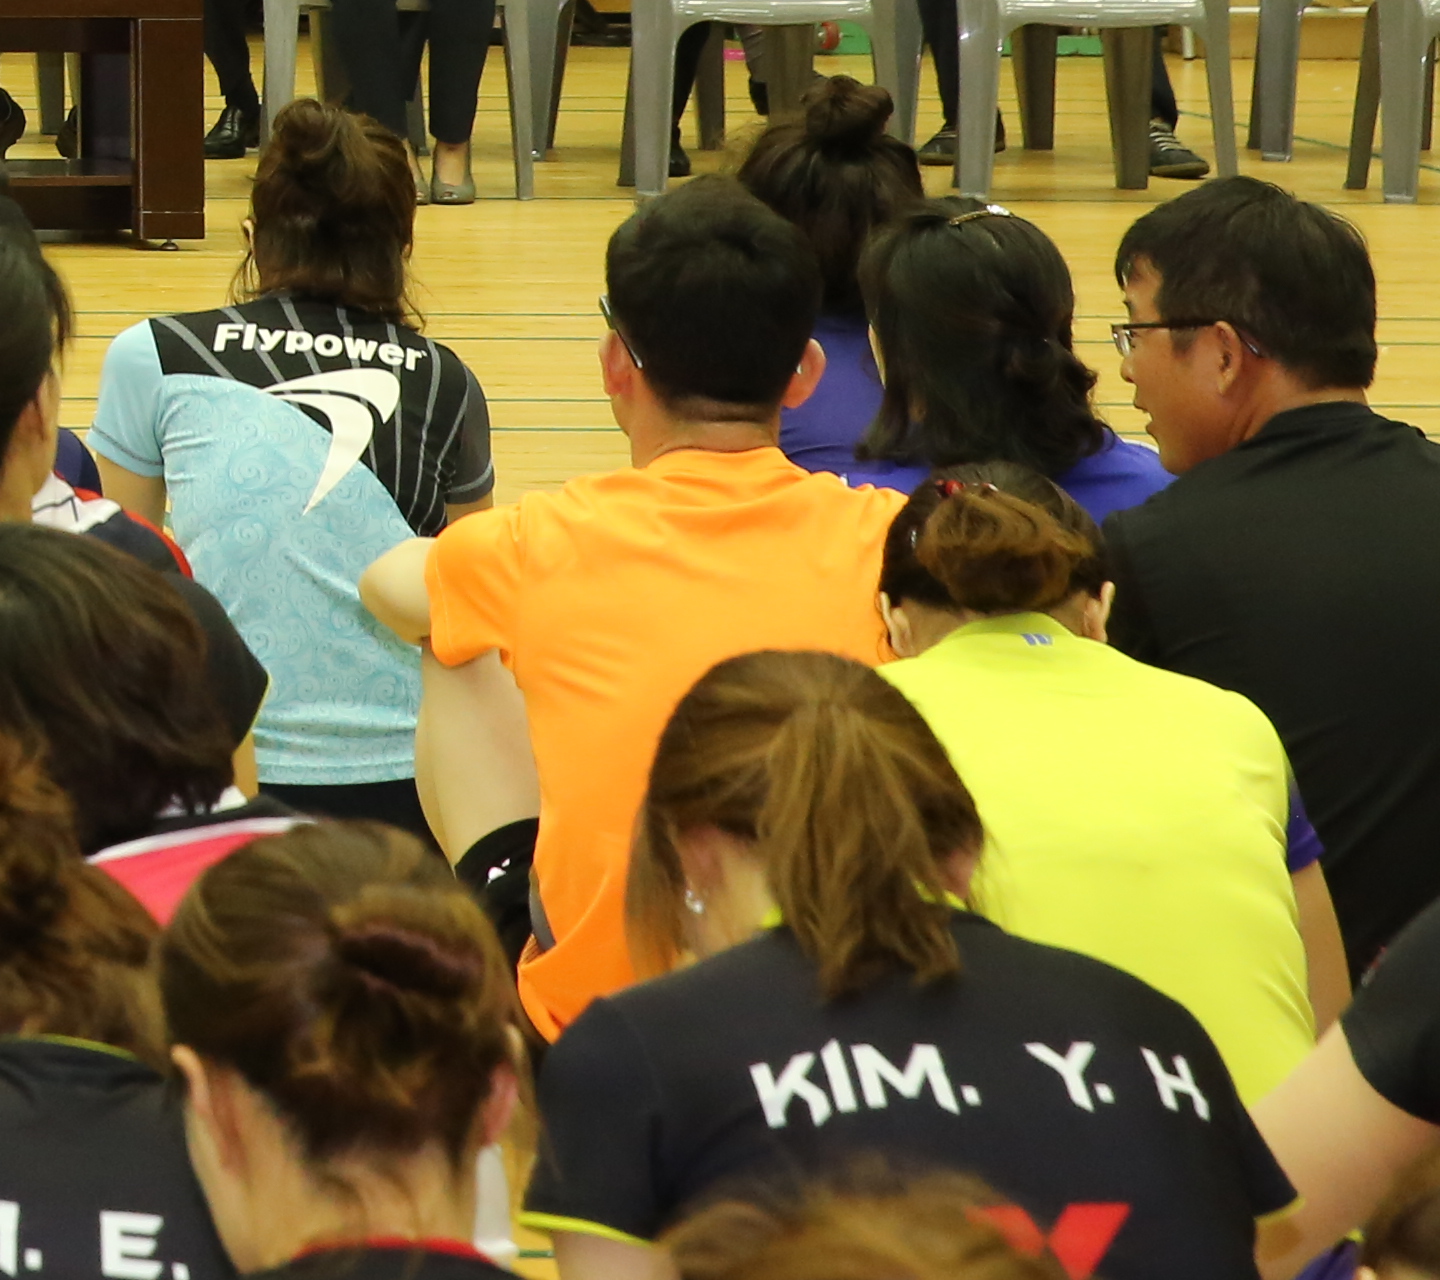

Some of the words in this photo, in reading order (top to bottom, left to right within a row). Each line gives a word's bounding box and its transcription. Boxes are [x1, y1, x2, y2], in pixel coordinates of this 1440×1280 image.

[213, 321, 426, 371] Flypower
[749, 1037, 982, 1130] KIM.
[1025, 1039, 1115, 1111] Y.
[1139, 1044, 1210, 1124] H
